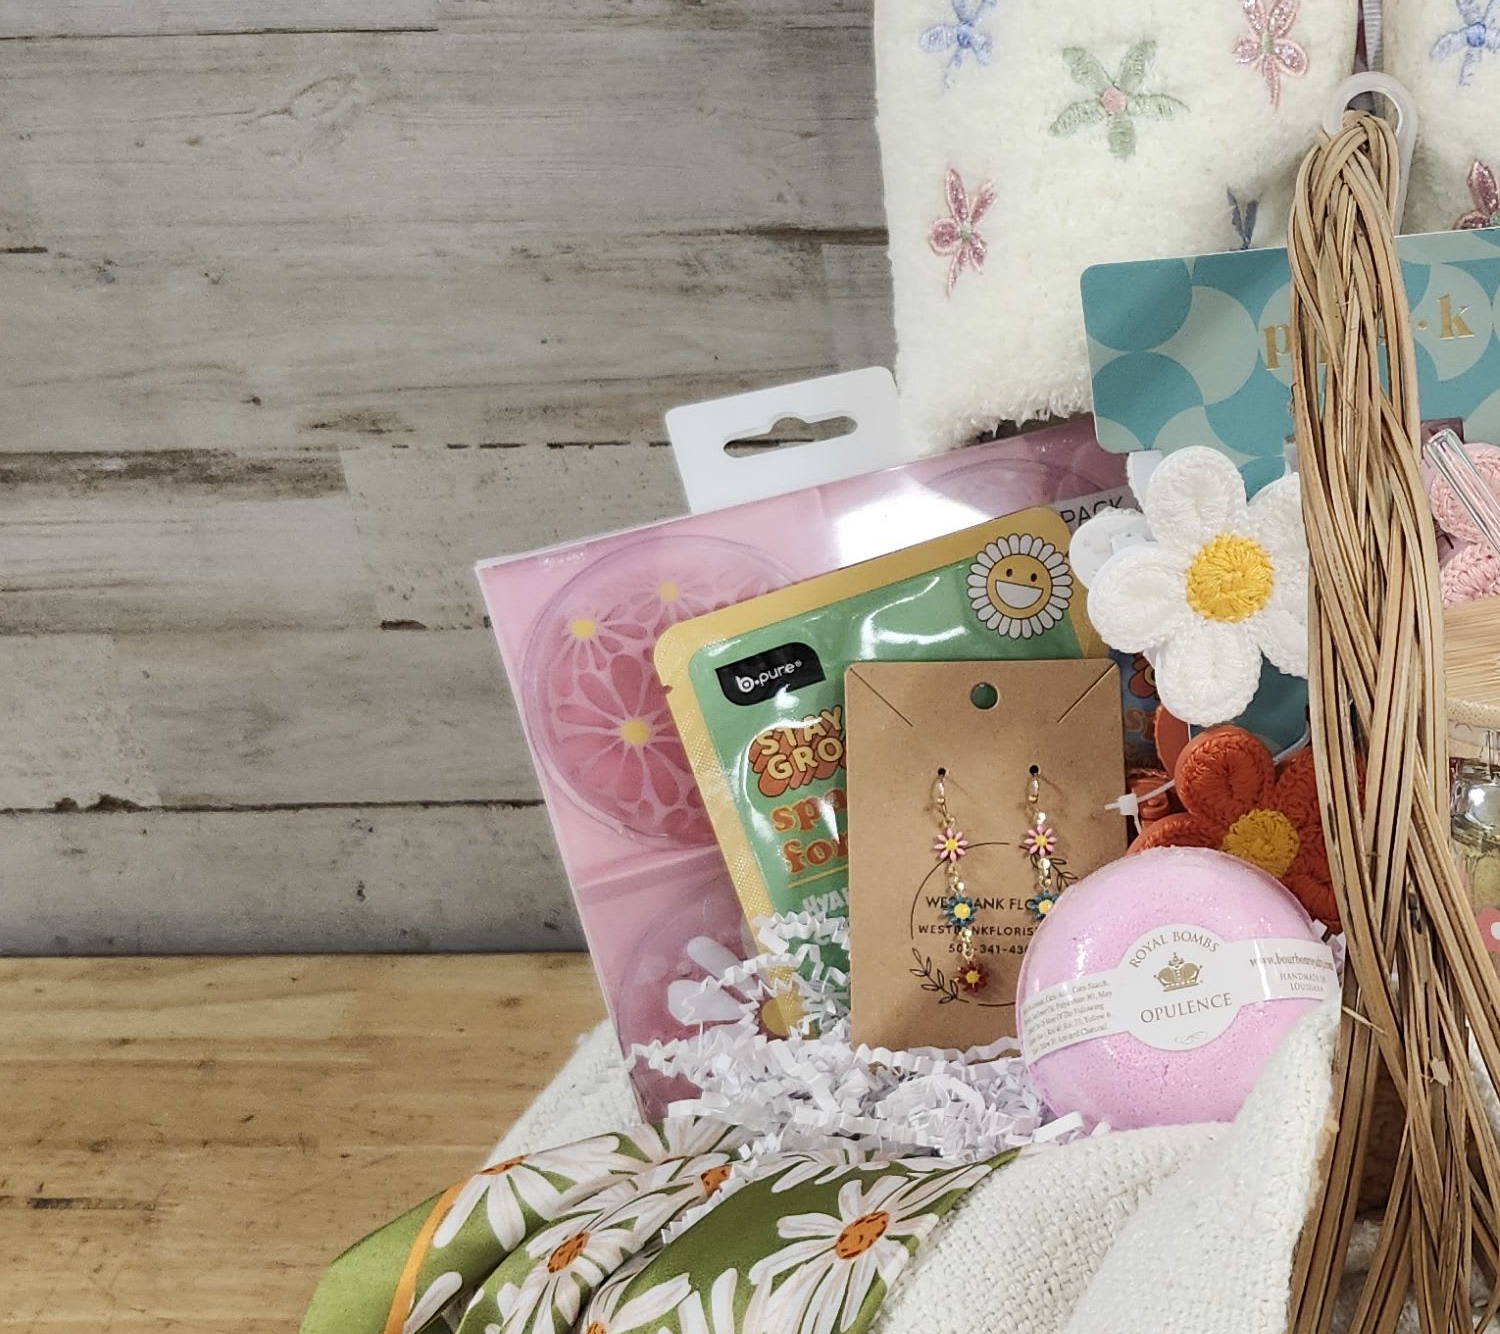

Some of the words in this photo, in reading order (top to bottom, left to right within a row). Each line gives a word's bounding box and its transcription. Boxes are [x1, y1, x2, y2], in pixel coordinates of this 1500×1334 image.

[755, 705, 843, 756] STAY
[766, 736, 847, 780] GRO
[1129, 934, 1169, 968] ROYAL
[1172, 930, 1220, 953] BOMBS
[1140, 992, 1233, 1023] OPULENCE
